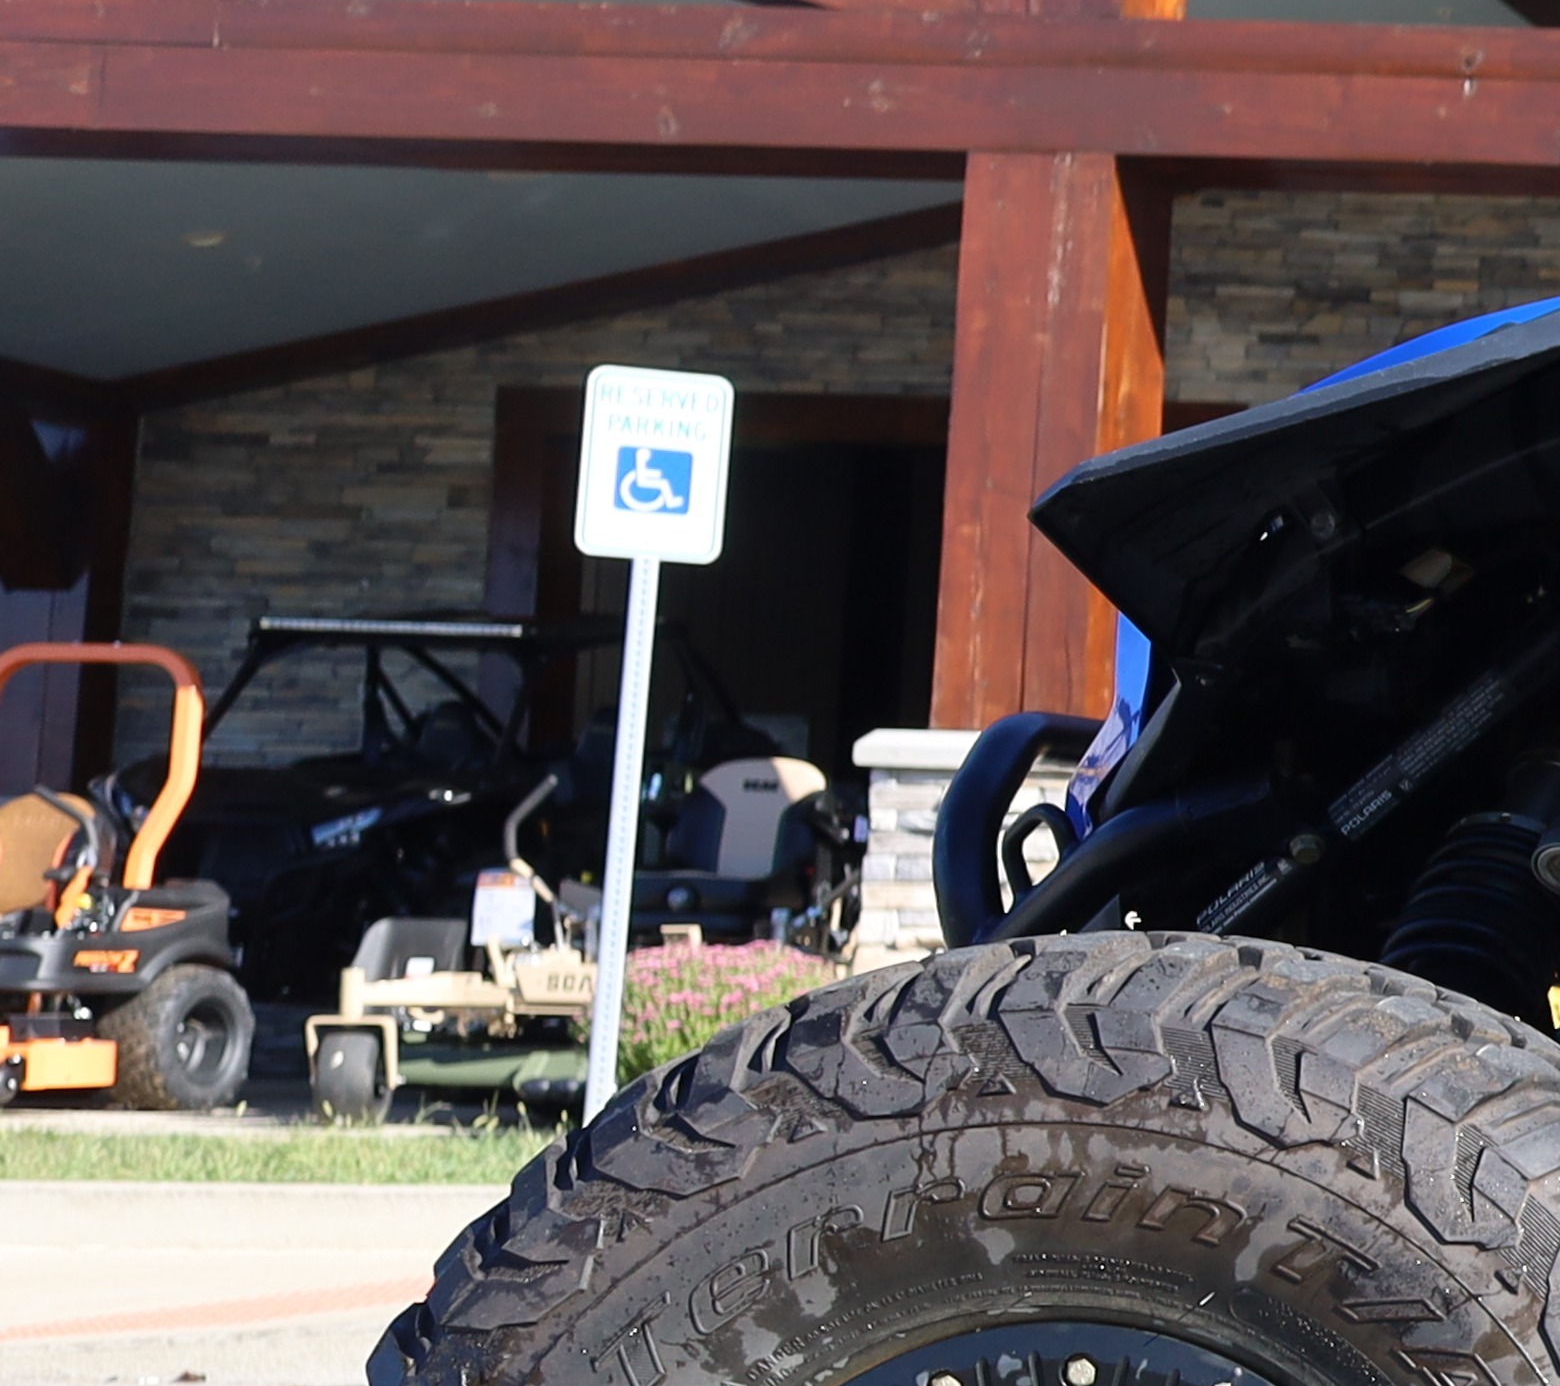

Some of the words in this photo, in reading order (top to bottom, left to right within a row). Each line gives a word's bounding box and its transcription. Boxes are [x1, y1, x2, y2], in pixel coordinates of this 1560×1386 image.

[601, 382, 720, 414] RESERVED
[608, 413, 707, 441] PARKING
[1340, 789, 1393, 837] POLARIS
[547, 972, 594, 994] SCA
